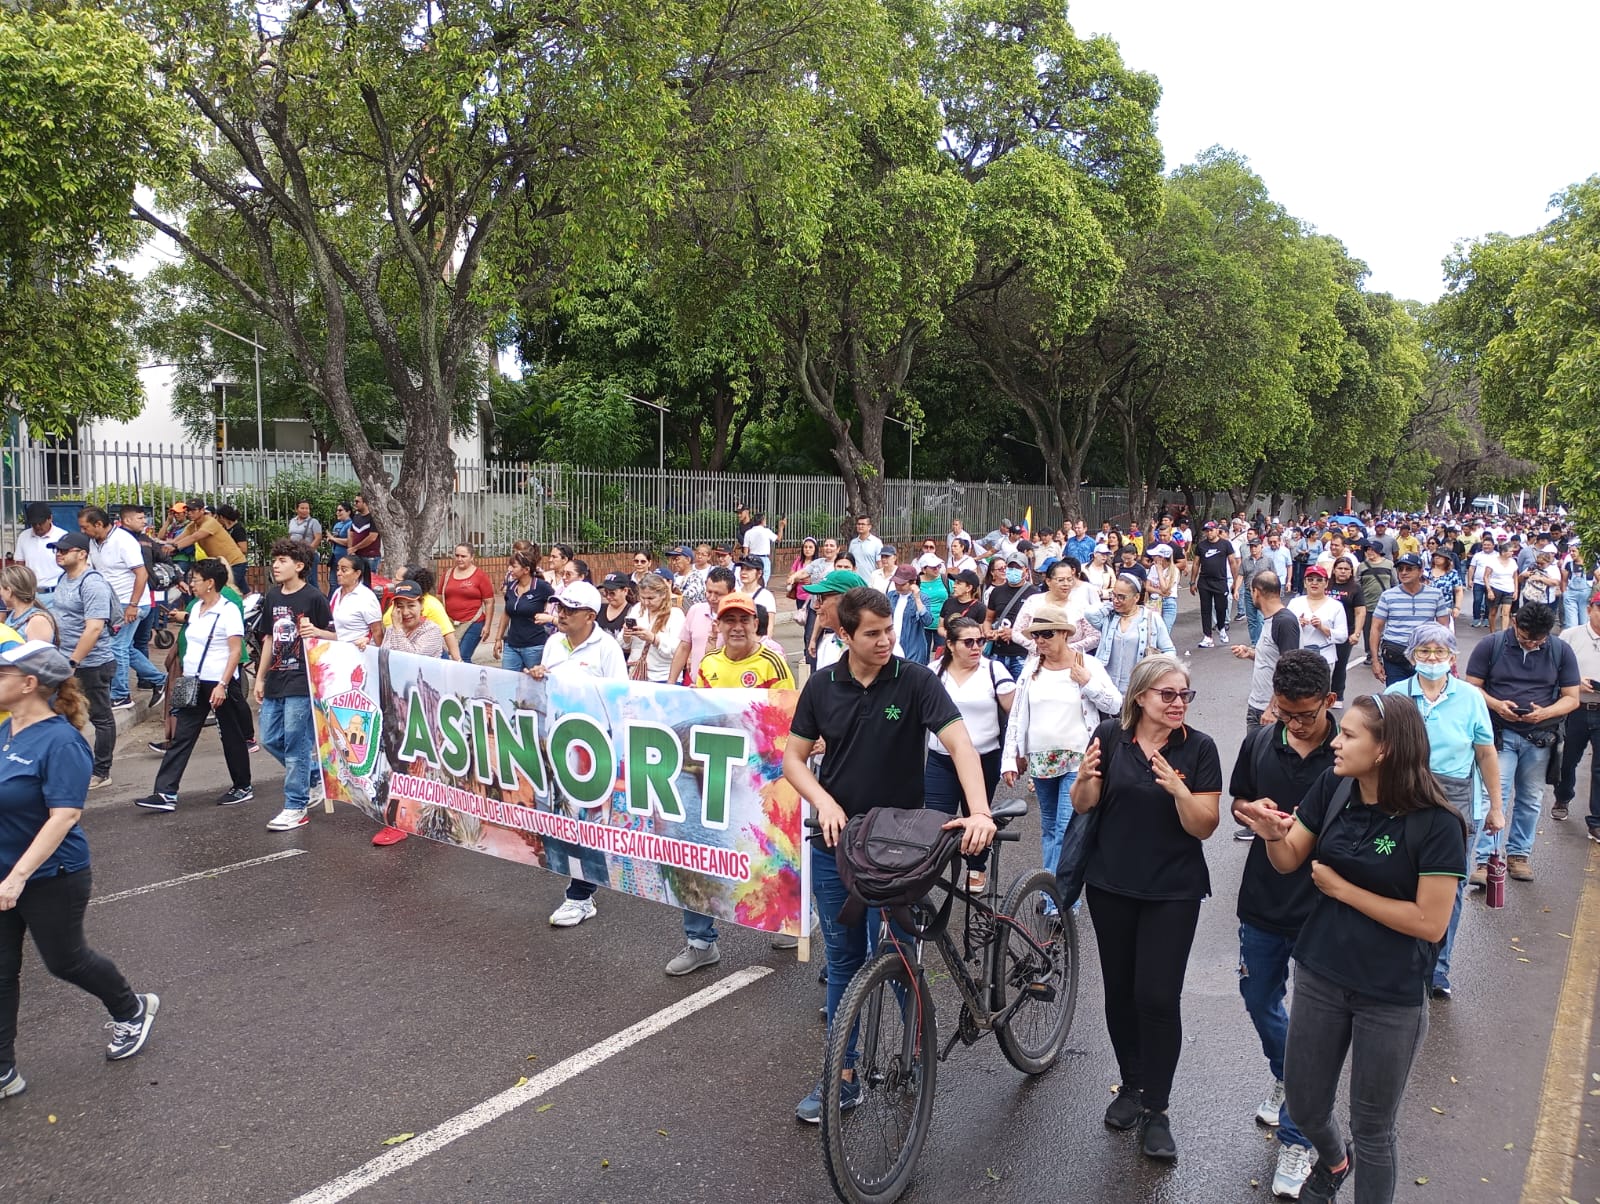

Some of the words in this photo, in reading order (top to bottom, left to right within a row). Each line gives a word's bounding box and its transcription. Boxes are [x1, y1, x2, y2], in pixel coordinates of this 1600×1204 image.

[332, 691, 371, 710] ASINORT
[400, 690, 746, 826] ASINORT
[391, 773, 447, 804] ASOCIACIÓN
[449, 787, 487, 813] SINDICAL
[487, 801, 502, 822] DE
[502, 803, 577, 843] INSTITUTORES
[579, 823, 749, 881] NORTESANTANDEREANOS
